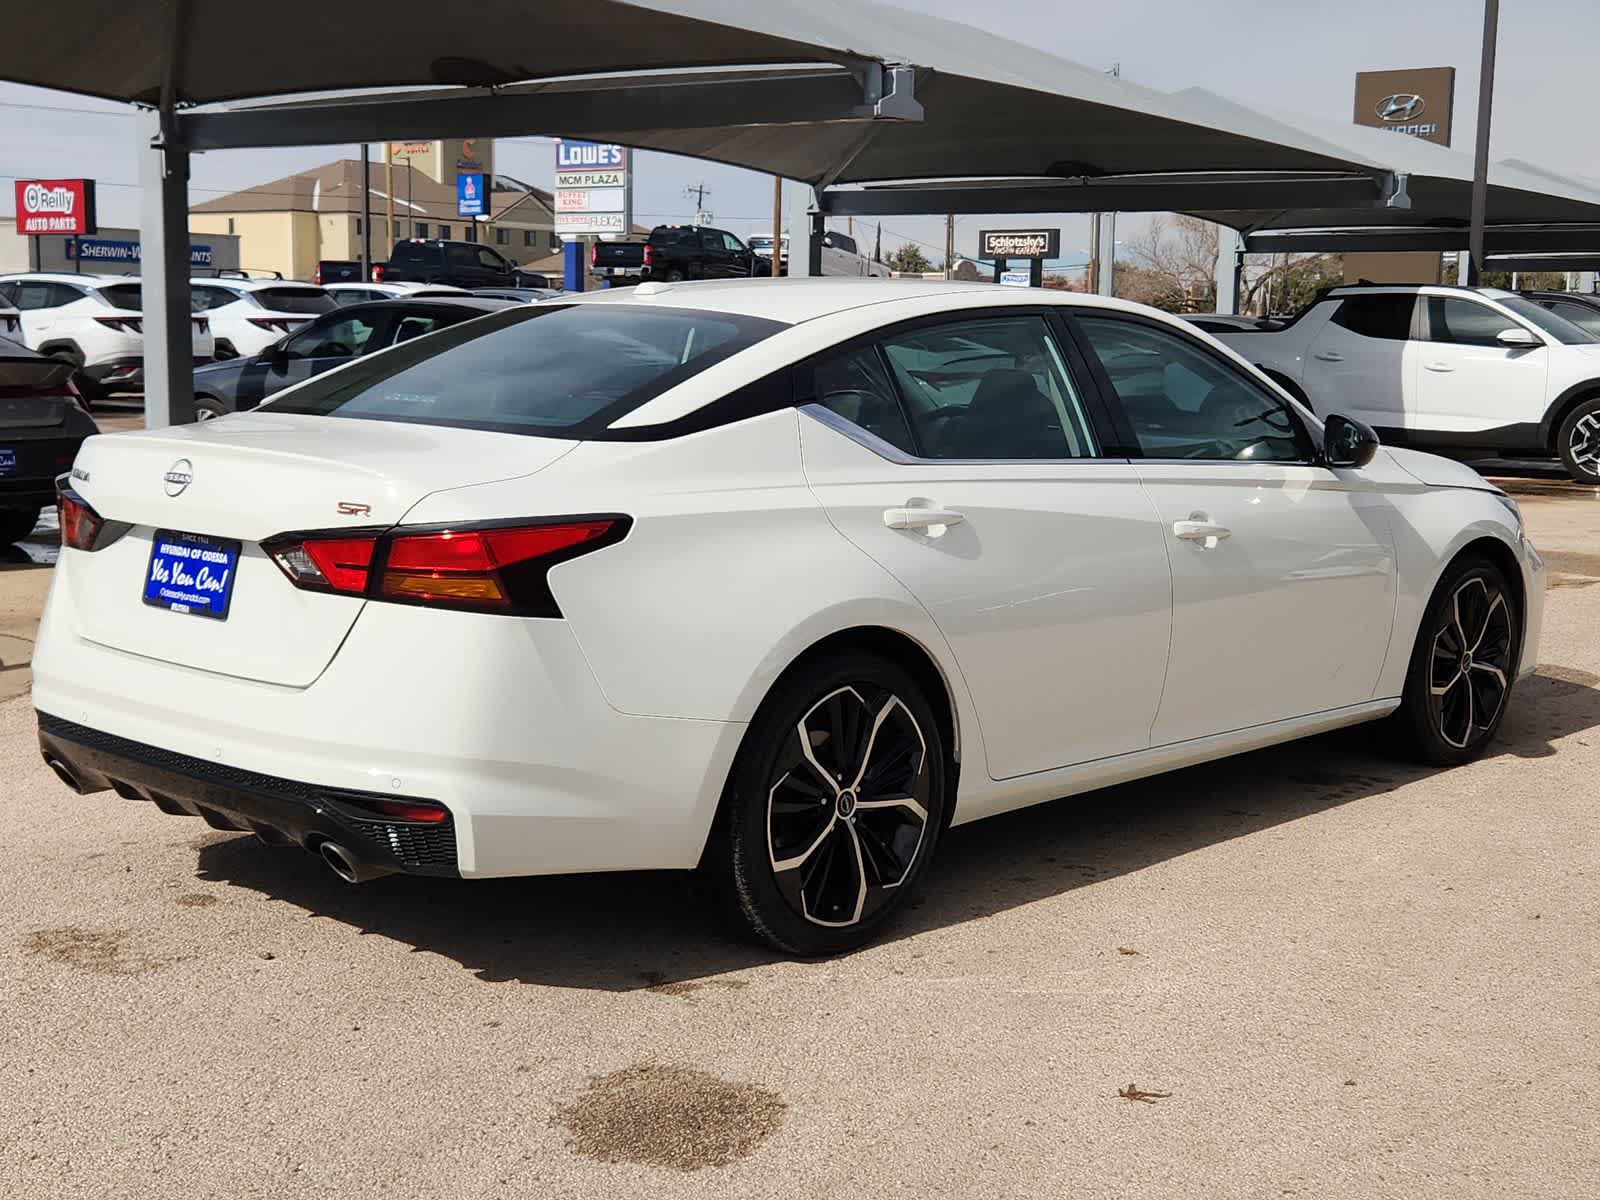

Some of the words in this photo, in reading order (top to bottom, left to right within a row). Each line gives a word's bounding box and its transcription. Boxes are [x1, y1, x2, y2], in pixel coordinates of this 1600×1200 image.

[559, 144, 622, 166] LOWE'S
[559, 175, 582, 185] MCM
[585, 174, 619, 184] PLAZA
[26, 186, 73, 213] O'Reilly
[558, 191, 587, 199] BUFFET
[25, 217, 48, 231] AUTO
[49, 217, 77, 231] PARTS
[989, 236, 1045, 249] Schlotzsky's
[81, 243, 142, 258] SHERWIN-W
[191, 251, 212, 263] INTS
[337, 502, 371, 517] SR
[160, 543, 191, 558] HYUNDAI
[191, 548, 203, 559] OF
[202, 550, 228, 564] ODESSA
[151, 558, 169, 583] Yes
[171, 561, 195, 586] You
[195, 566, 229, 593] Can!
